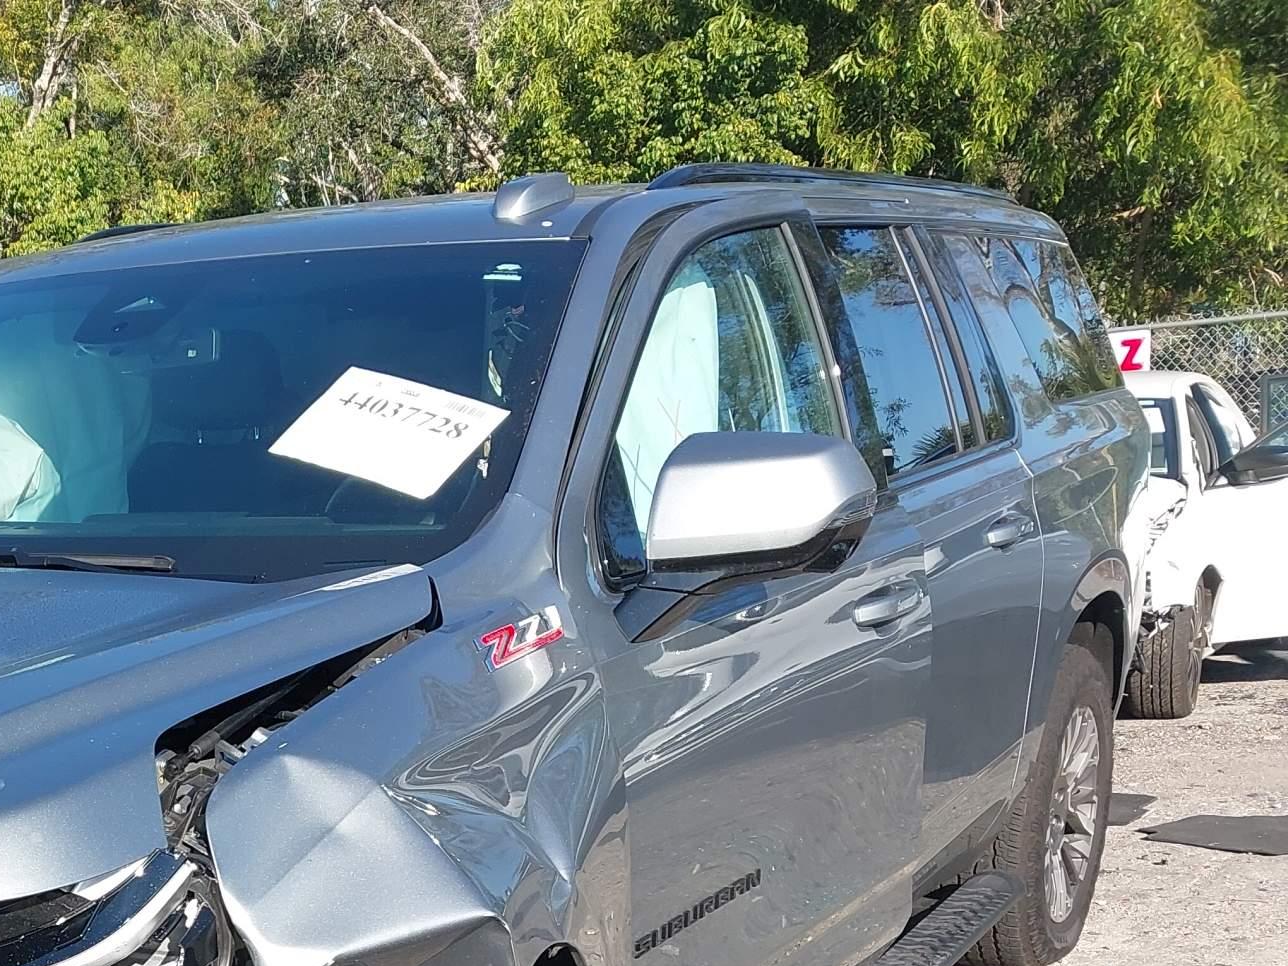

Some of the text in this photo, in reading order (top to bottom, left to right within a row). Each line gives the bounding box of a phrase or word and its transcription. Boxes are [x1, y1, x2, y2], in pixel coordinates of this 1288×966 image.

[1120, 338, 1143, 372] Z
[339, 391, 469, 439] 44037728
[473, 604, 564, 672] Z71
[633, 868, 762, 960] SUBURBAN
